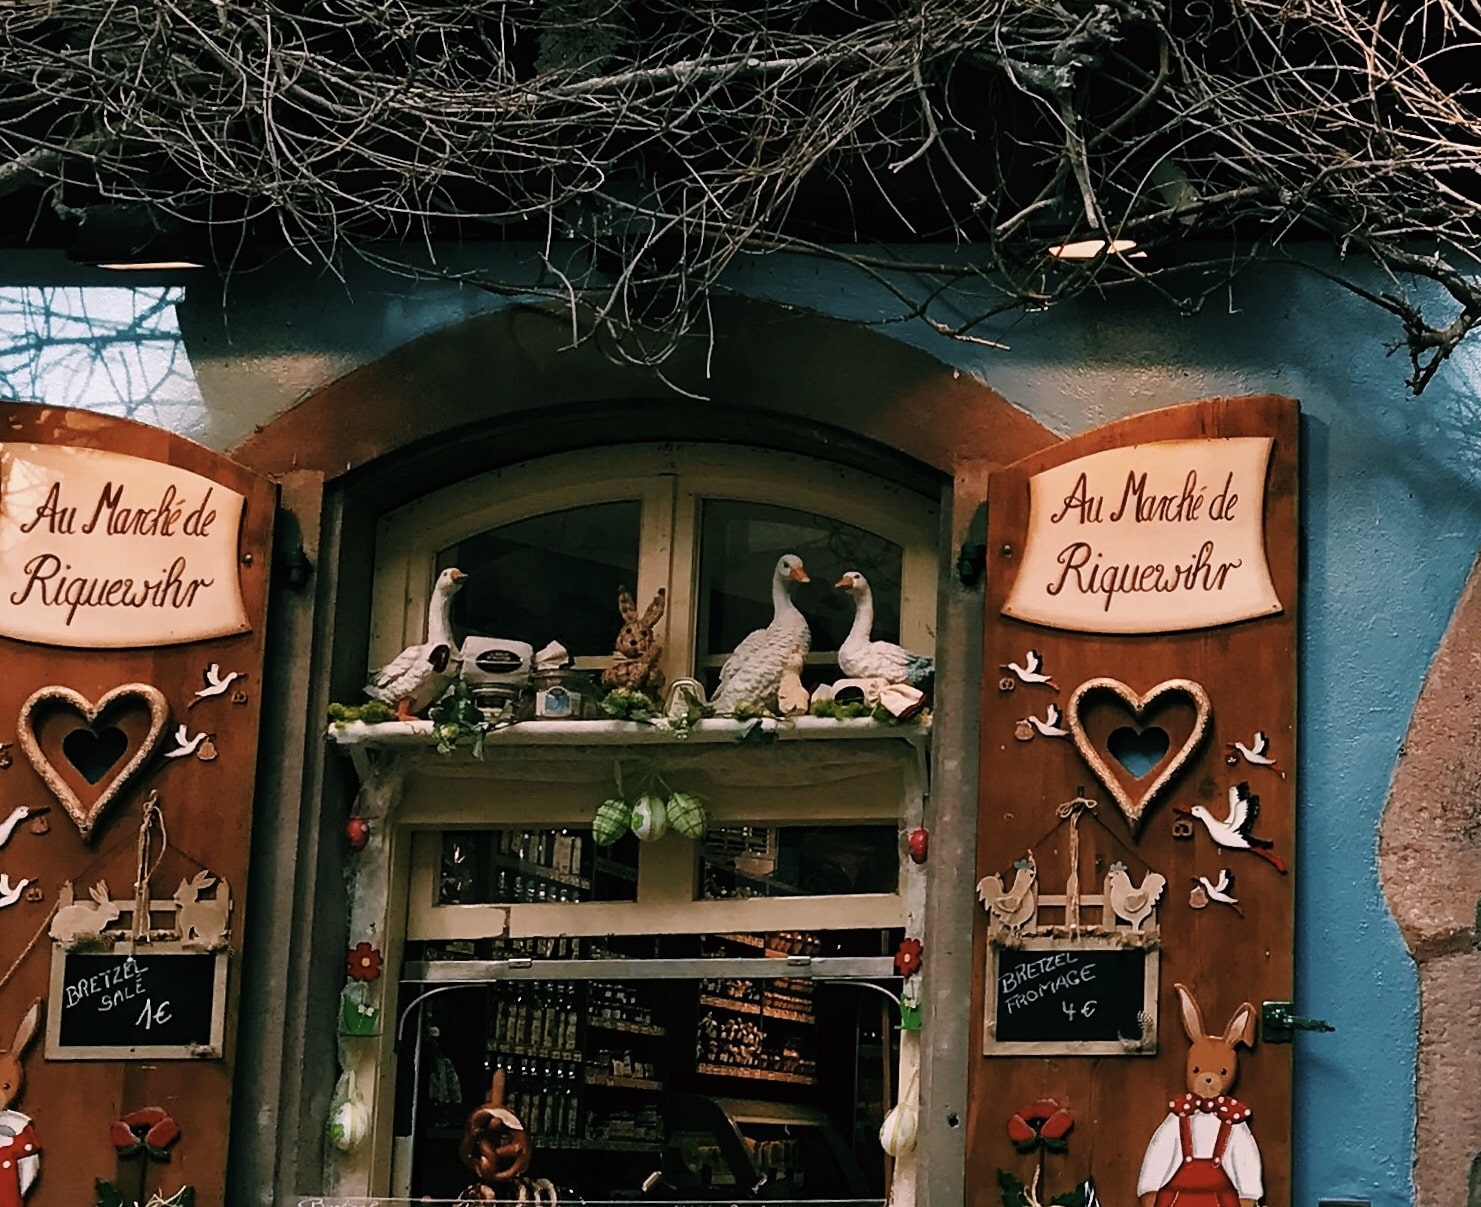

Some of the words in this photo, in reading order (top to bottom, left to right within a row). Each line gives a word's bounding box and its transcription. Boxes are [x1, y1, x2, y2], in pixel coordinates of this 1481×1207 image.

[20, 481, 77, 535] Au
[82, 481, 186, 537] Marché
[183, 486, 217, 537] de
[1050, 471, 1103, 524] Au
[1109, 469, 1208, 524] Marché
[1208, 470, 1239, 522] de
[9, 553, 215, 627] Riquewihr
[1046, 540, 1243, 613] Riquewihr
[66, 959, 149, 1009] BRETZEL
[998, 952, 1079, 994] BRETZEL
[1005, 963, 1097, 1015] FROMAGE
